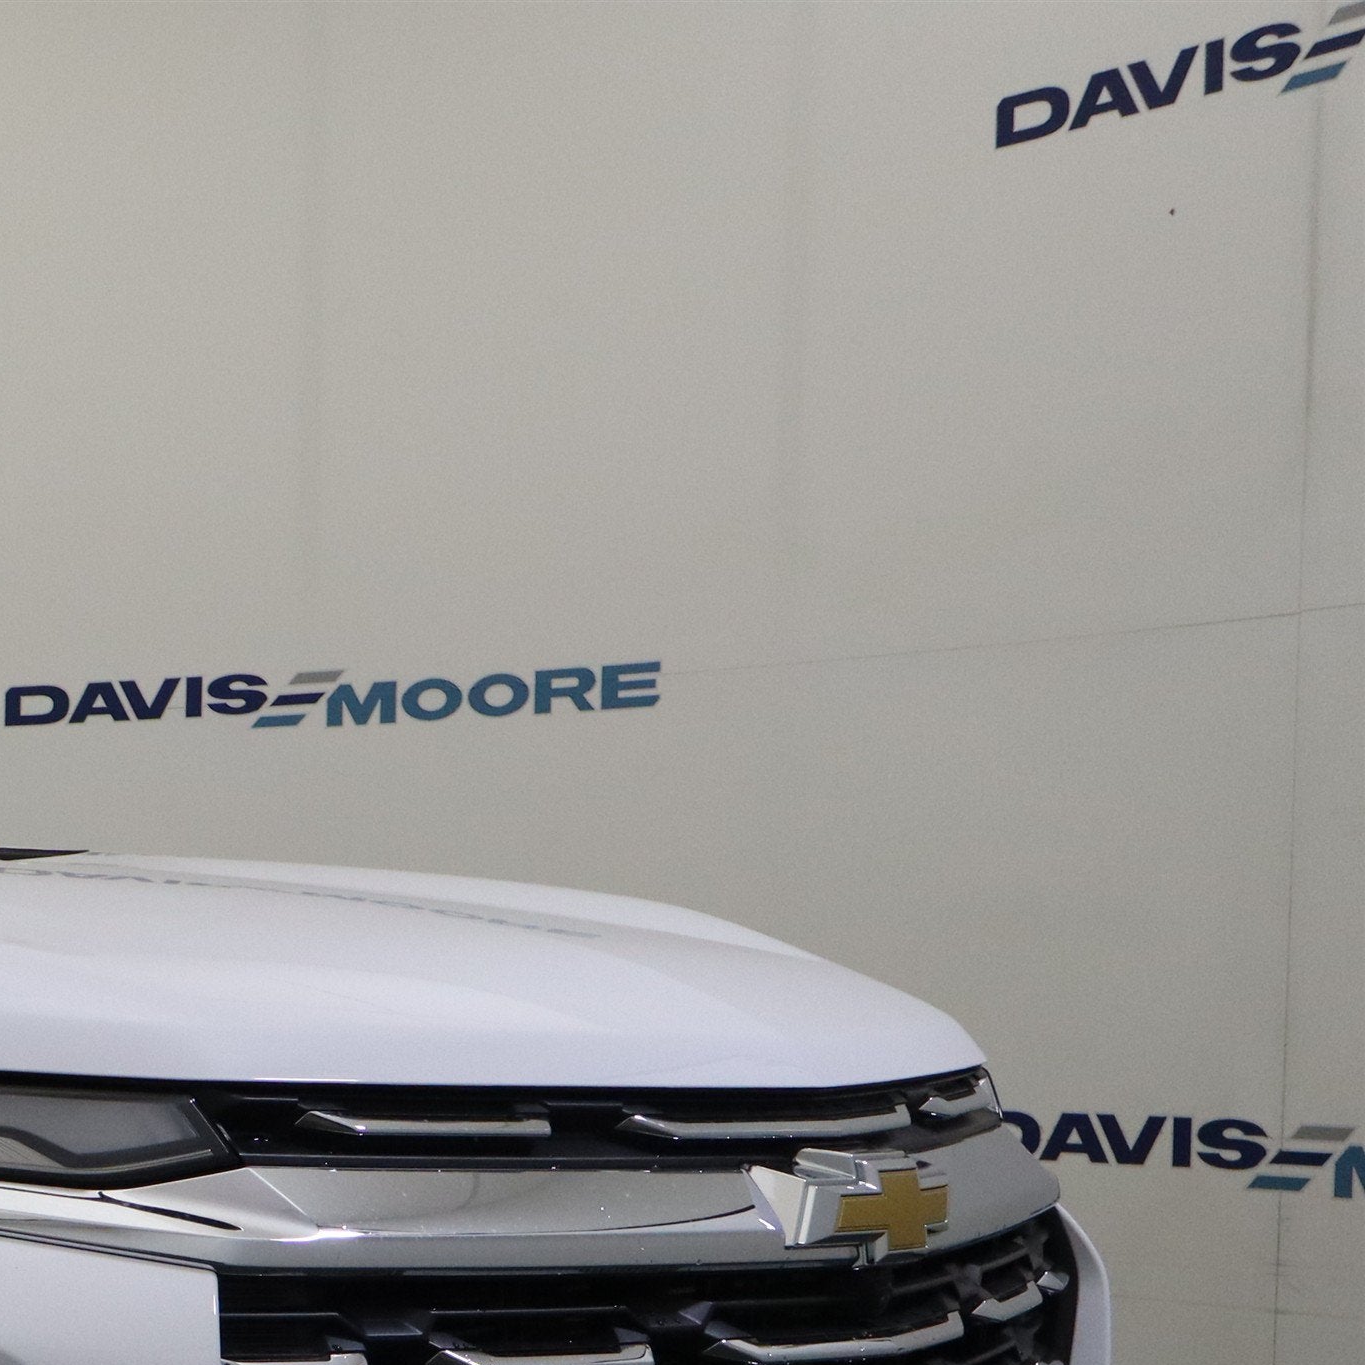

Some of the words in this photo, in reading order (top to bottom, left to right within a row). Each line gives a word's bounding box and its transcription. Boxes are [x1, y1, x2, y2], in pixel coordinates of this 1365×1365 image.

[995, 22, 1302, 149] DAVIS
[3, 672, 269, 728] DAVIS
[325, 660, 662, 728] MOORE
